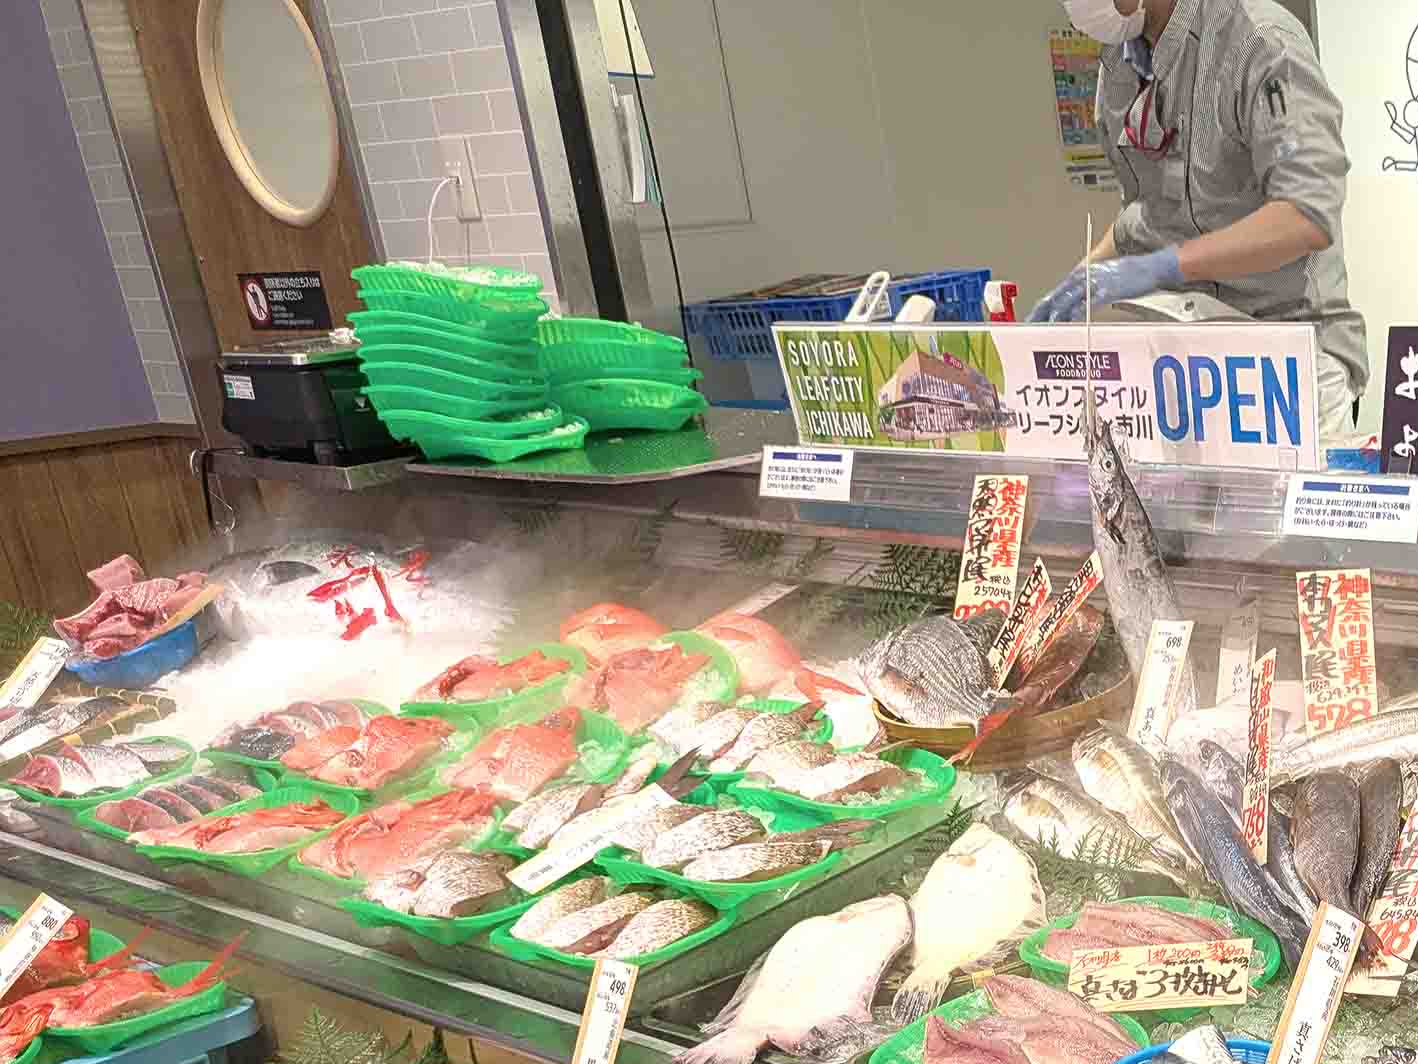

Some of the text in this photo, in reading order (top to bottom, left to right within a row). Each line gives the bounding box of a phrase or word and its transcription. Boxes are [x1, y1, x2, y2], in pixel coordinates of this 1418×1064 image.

[787, 339, 860, 370] SOYORA
[1056, 369, 1102, 378] FOOD&DUG
[795, 376, 864, 406] LEAFCITY
[1016, 385, 1147, 409] イオンスタイル
[1154, 355, 1300, 446] OPEN
[807, 408, 875, 440] ICHIKAWA
[1018, 413, 1154, 441] リーフシ市川
[991, 479, 1026, 568] 神奈川県産
